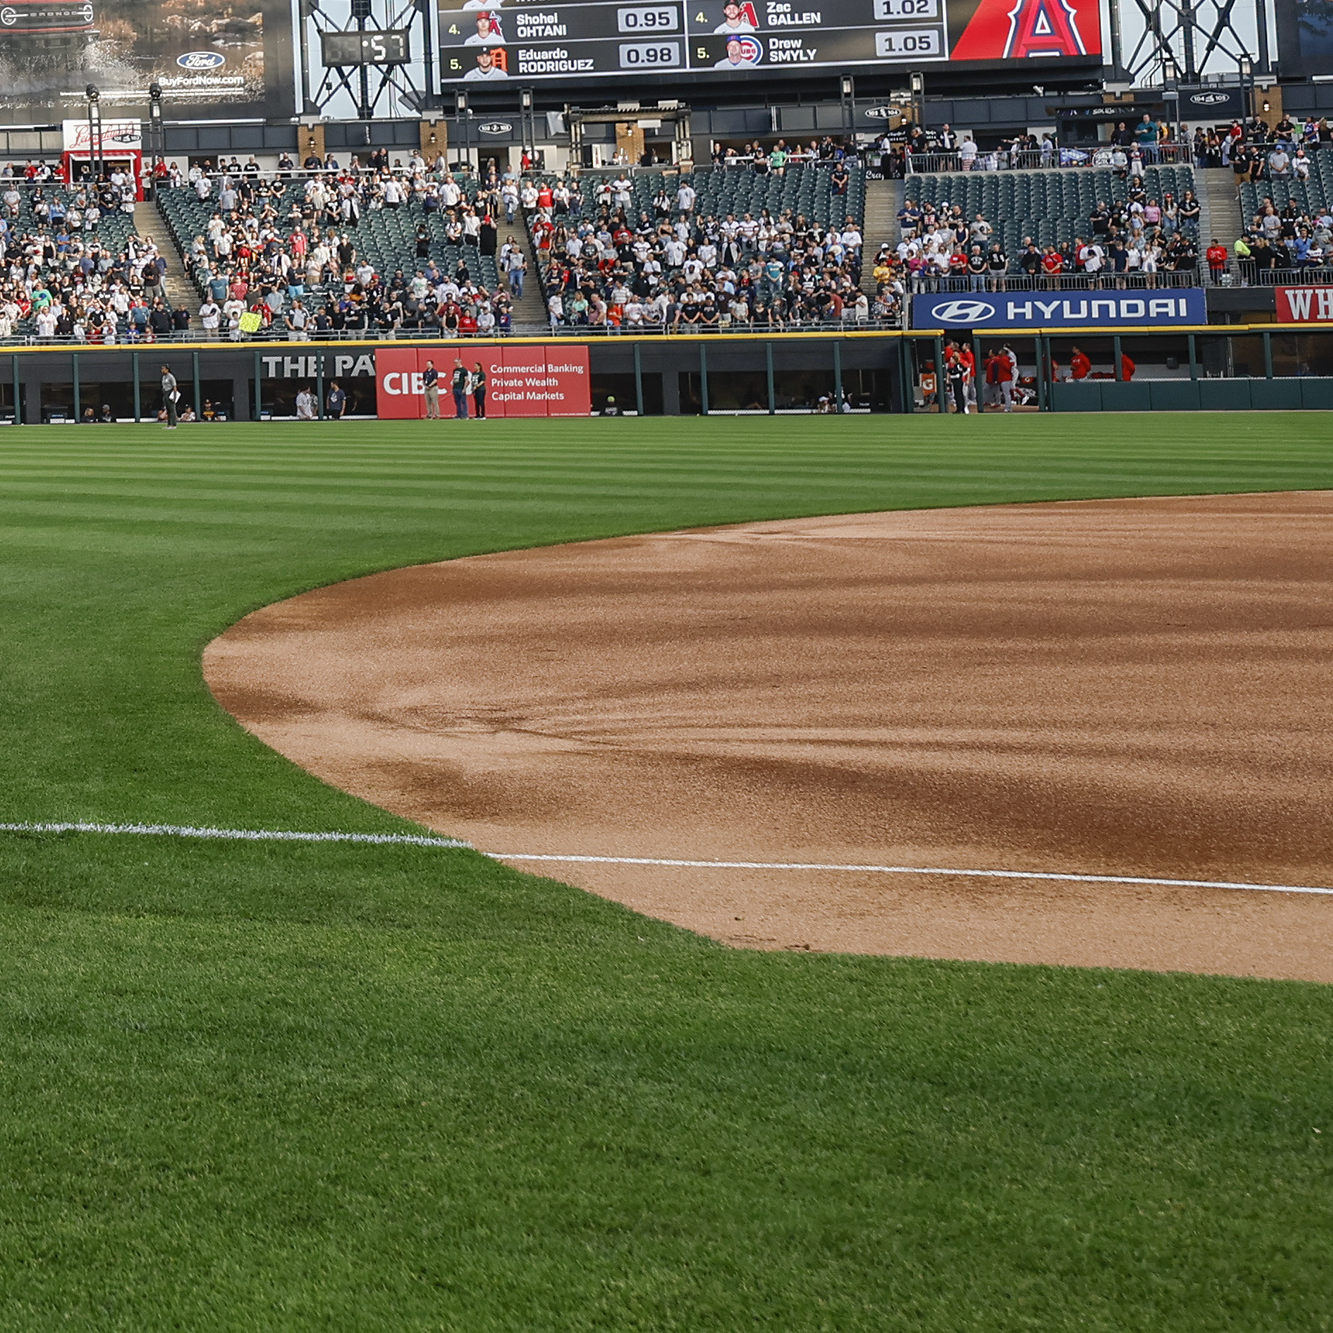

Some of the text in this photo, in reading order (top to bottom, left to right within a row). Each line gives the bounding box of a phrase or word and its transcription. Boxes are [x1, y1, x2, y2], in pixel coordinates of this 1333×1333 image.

[695, 12, 708, 23] 4.
[766, 1, 791, 13] Zac
[767, 12, 821, 26] GALLEN
[448, 24, 461, 35] 4.
[625, 12, 671, 29] 0.95
[517, 24, 567, 38] OHTANI
[696, 35, 931, 59] 5. Drew 1.05
[185, 54, 215, 67] Ford
[449, 48, 672, 70] 5. Eduardo 0.98
[769, 48, 817, 62] SMYLY
[519, 59, 594, 74] RODRIGUEZ
[158, 75, 244, 87] BuyFordNow.com
[1006, 297, 1188, 320] HYUNDAI
[262, 353, 376, 378] THE PA
[490, 363, 584, 376] Commercial Banking
[383, 371, 448, 395] CIBC
[491, 377, 559, 388] Private Wealth
[491, 390, 564, 403] Capital Markets
